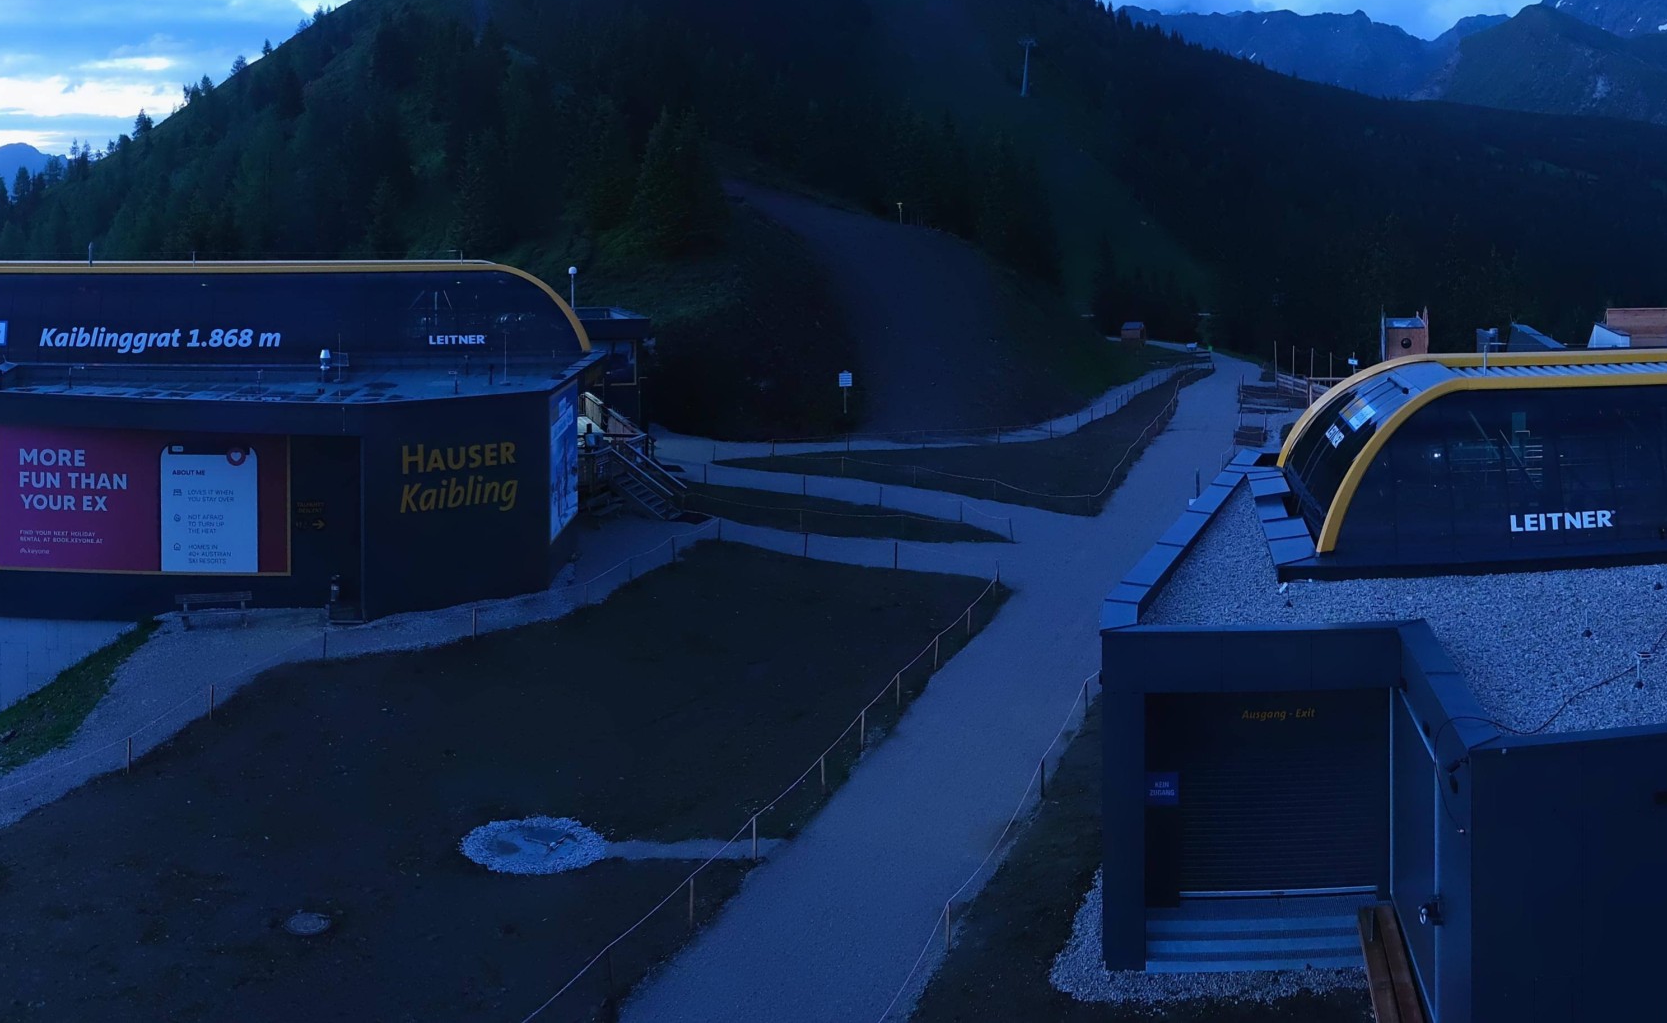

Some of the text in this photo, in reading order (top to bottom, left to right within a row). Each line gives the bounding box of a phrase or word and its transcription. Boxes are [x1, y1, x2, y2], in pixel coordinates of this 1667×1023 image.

[39, 327, 281, 354] Kaiblinggrat 1.868 m
[429, 335, 486, 345] LEITNER
[19, 448, 85, 467] MORE
[402, 442, 516, 475] HAUSER
[19, 471, 127, 490] FUN THAN
[20, 494, 108, 512] YOUR EX
[400, 475, 518, 514] Kaibling
[1510, 510, 1613, 532] LEITNER
[1241, 709, 1287, 722] Ausgang
[1295, 707, 1316, 719] Exit
[1154, 781, 1170, 789] KEIN
